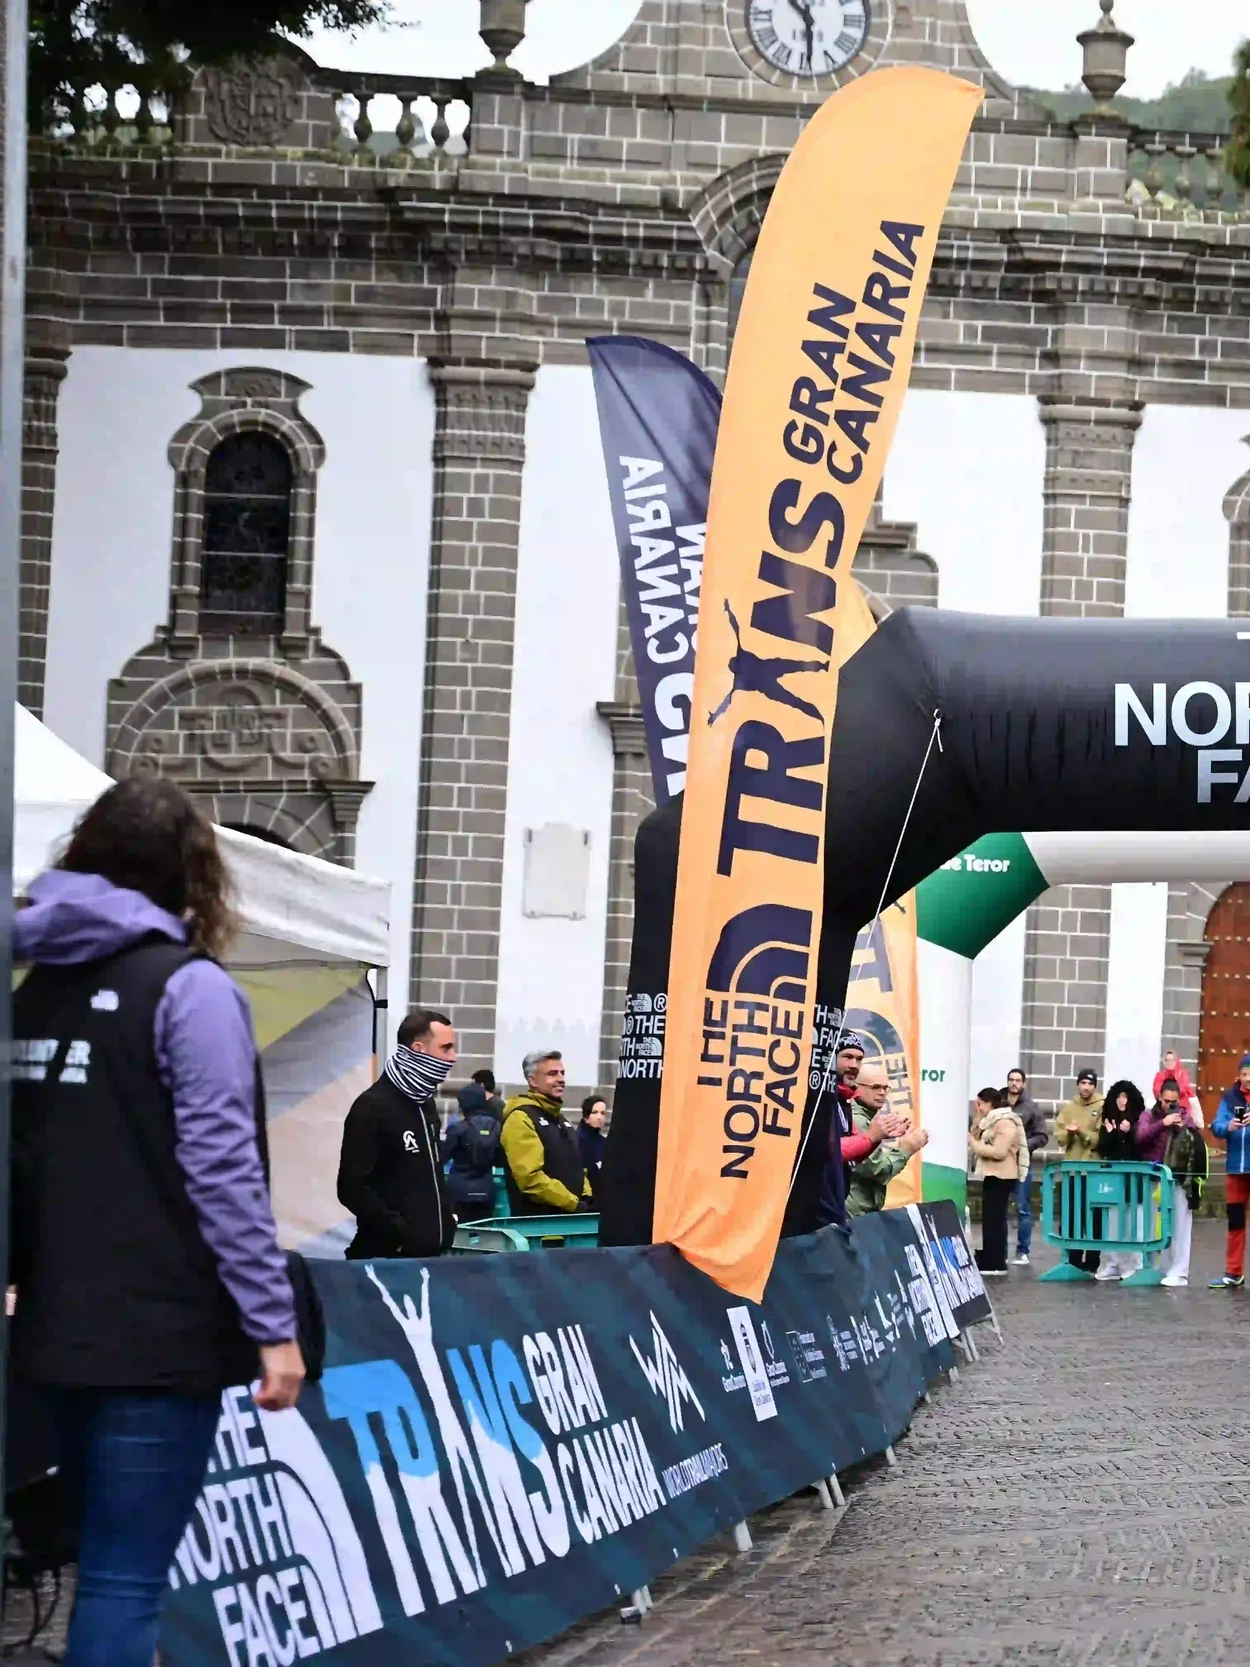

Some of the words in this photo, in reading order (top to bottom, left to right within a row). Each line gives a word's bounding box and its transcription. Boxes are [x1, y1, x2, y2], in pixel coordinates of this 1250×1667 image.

[783, 282, 857, 464] GRAN
[826, 220, 925, 484] CANARIA
[963, 853, 1010, 872] Teror
[635, 1015, 666, 1034] THE
[762, 1006, 805, 1137] FACE
[922, 1069, 946, 1083] ror
[720, 1000, 770, 1179] NORTH
[208, 1384, 268, 1473] HE
[522, 1324, 608, 1436] GRAN
[557, 1416, 667, 1544] CANARIA
[212, 1566, 321, 1667] FACE
